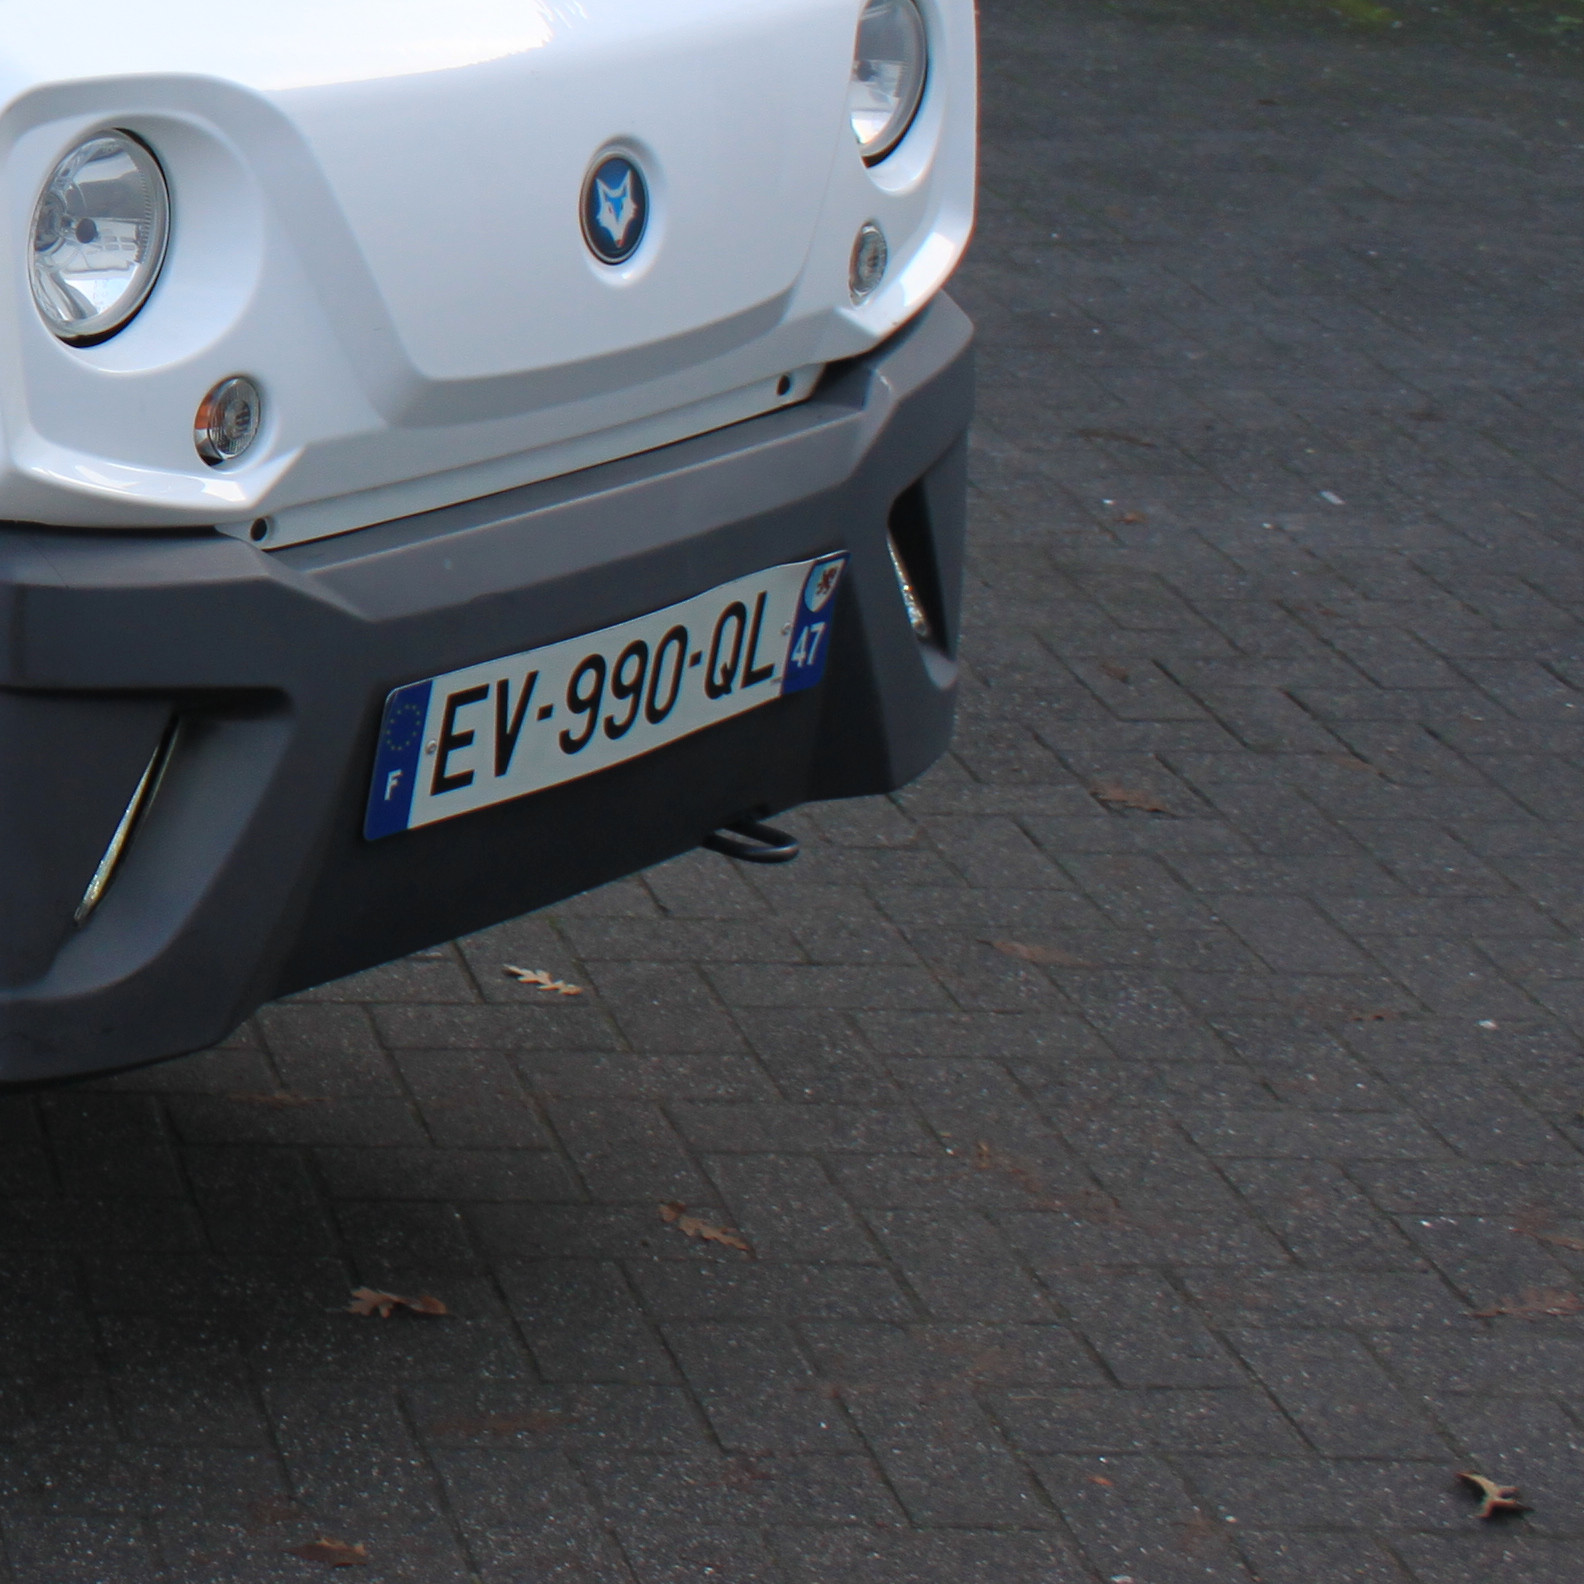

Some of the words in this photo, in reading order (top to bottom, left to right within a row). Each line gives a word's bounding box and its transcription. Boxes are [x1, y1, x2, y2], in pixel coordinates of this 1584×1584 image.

[790, 620, 826, 668] 47
[429, 590, 776, 797] EV-990-QL
[384, 769, 403, 801] F
